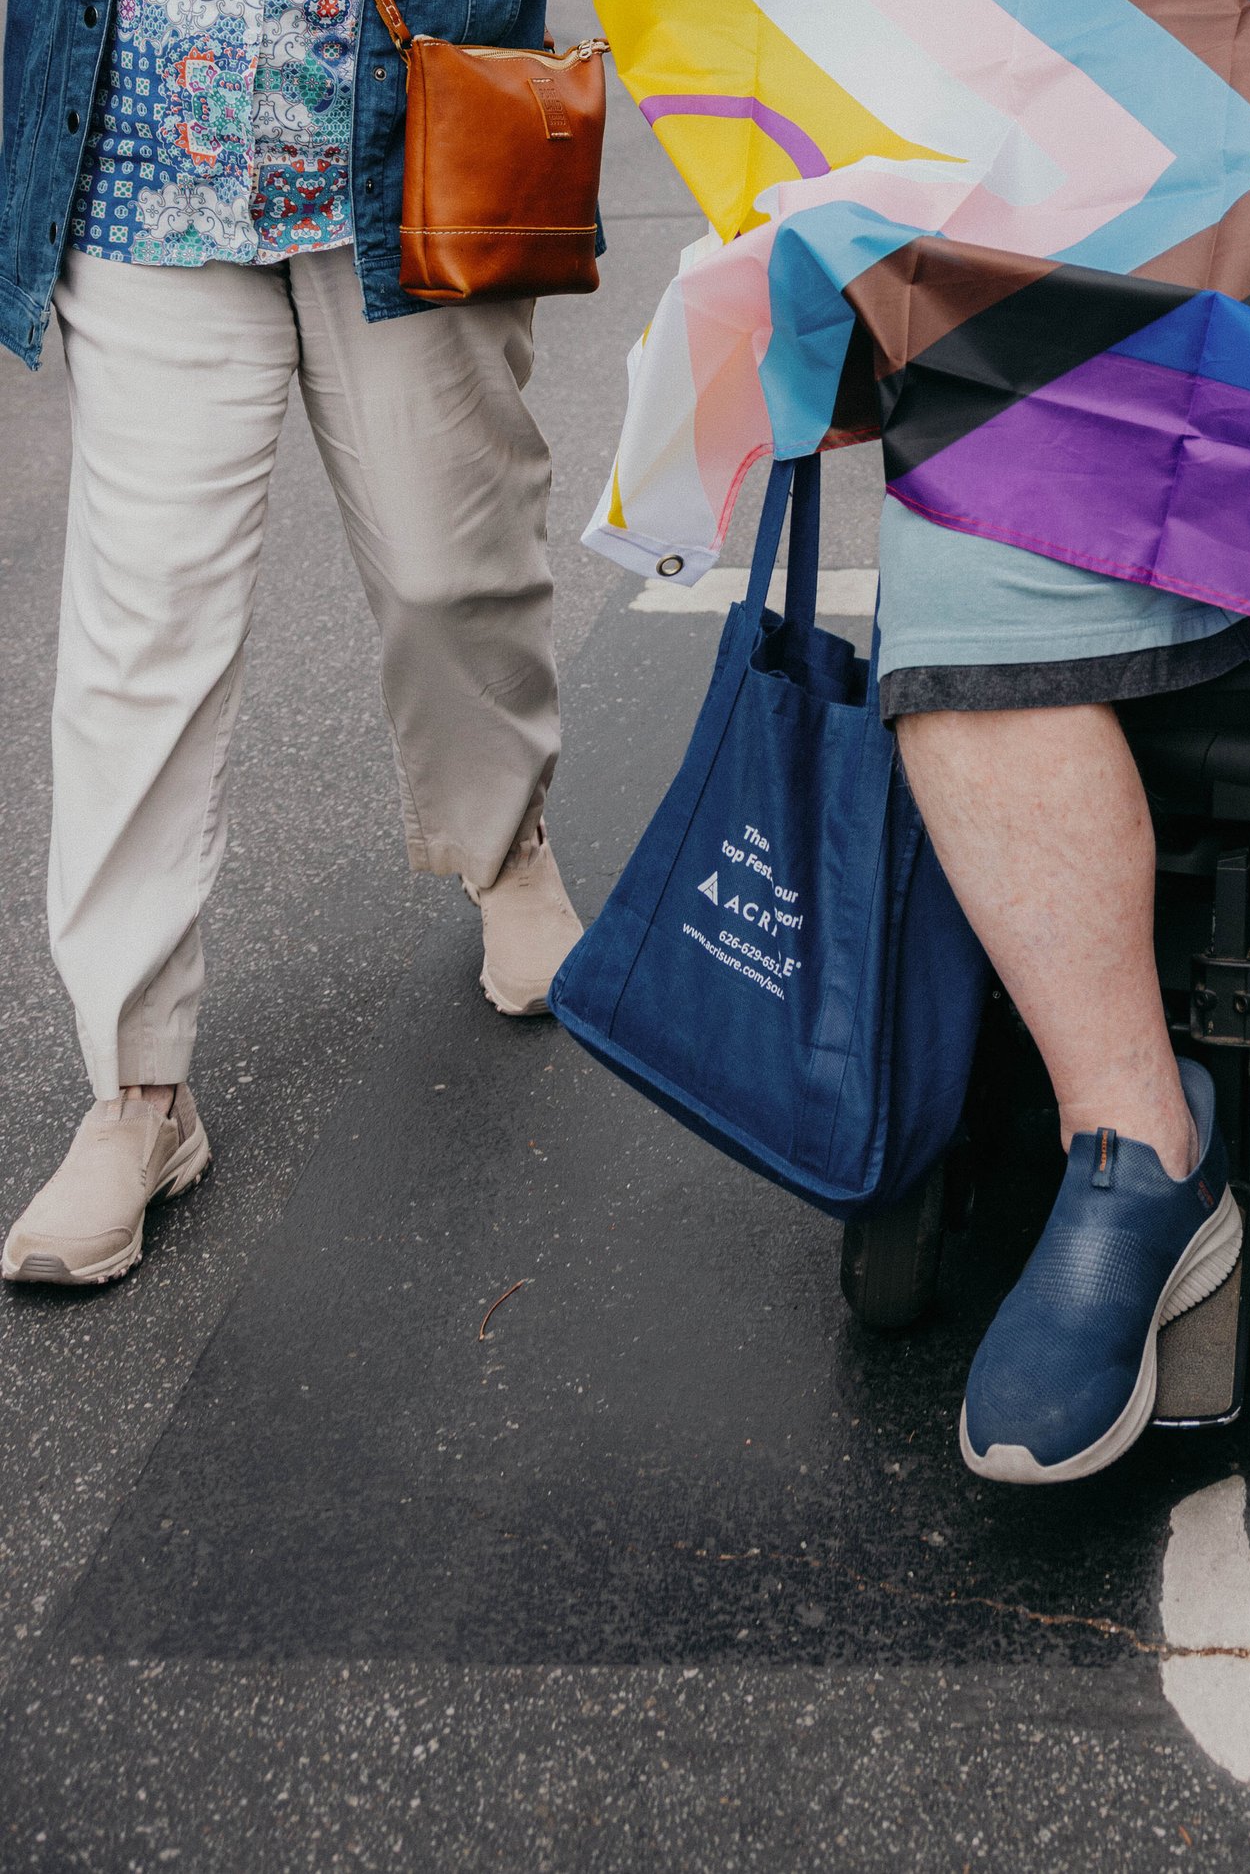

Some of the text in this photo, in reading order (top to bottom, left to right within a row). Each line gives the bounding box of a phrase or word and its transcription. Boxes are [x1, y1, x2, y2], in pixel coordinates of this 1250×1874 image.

[722, 840, 745, 864] top
[745, 852, 774, 884] Fest
[774, 885, 799, 904] our
[682, 922, 785, 1001] www.acrisure.com/sou
[718, 930, 783, 979] 626-629-651
